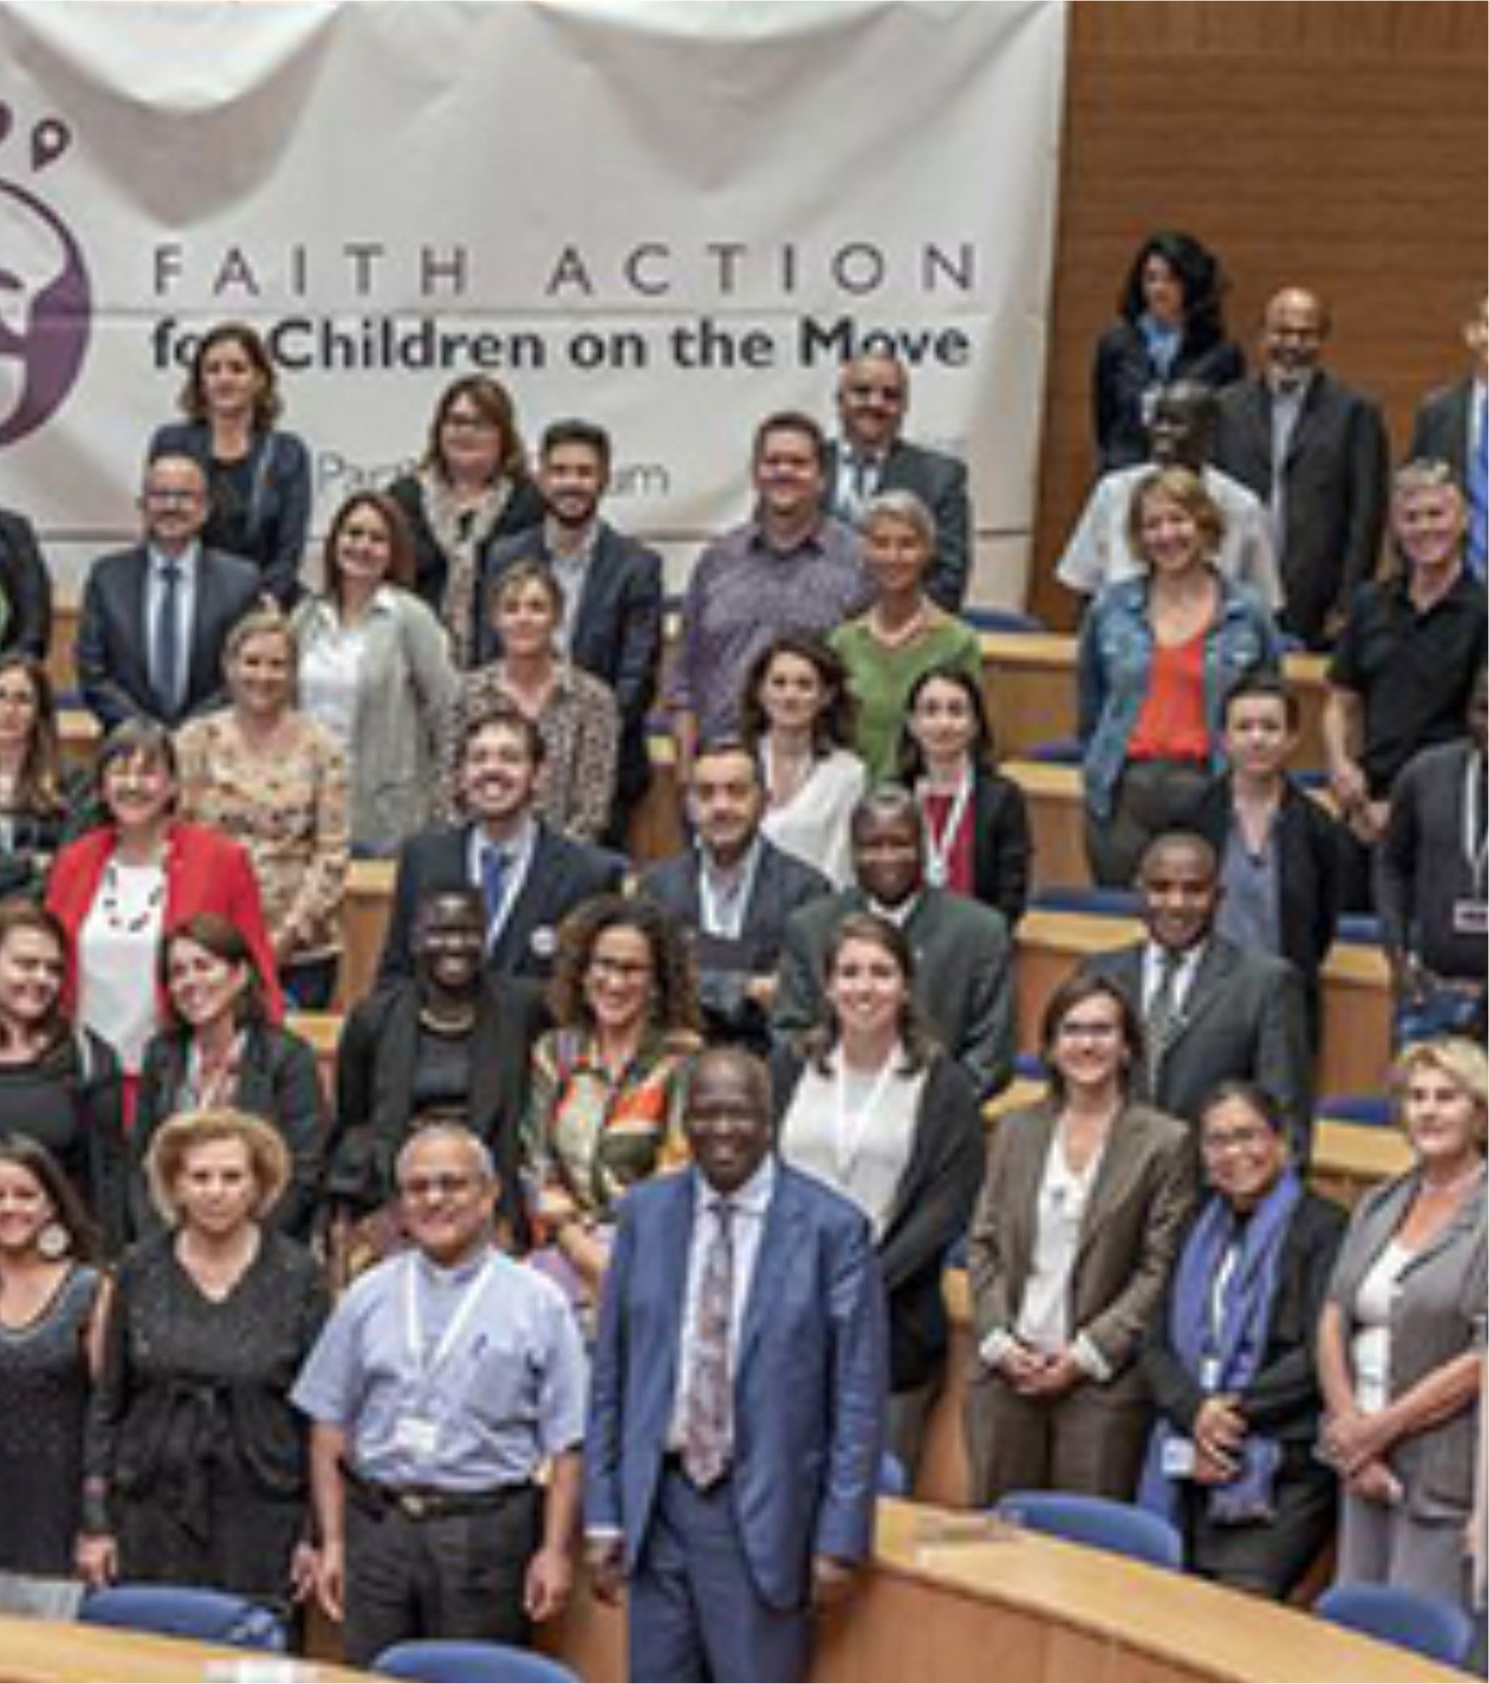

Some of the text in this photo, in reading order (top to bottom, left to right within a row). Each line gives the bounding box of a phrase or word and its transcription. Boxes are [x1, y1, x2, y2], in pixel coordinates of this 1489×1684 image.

[152, 241, 975, 297] FAITH ACTION
[268, 316, 546, 370] Children
[567, 326, 649, 369] on
[669, 314, 776, 369] the
